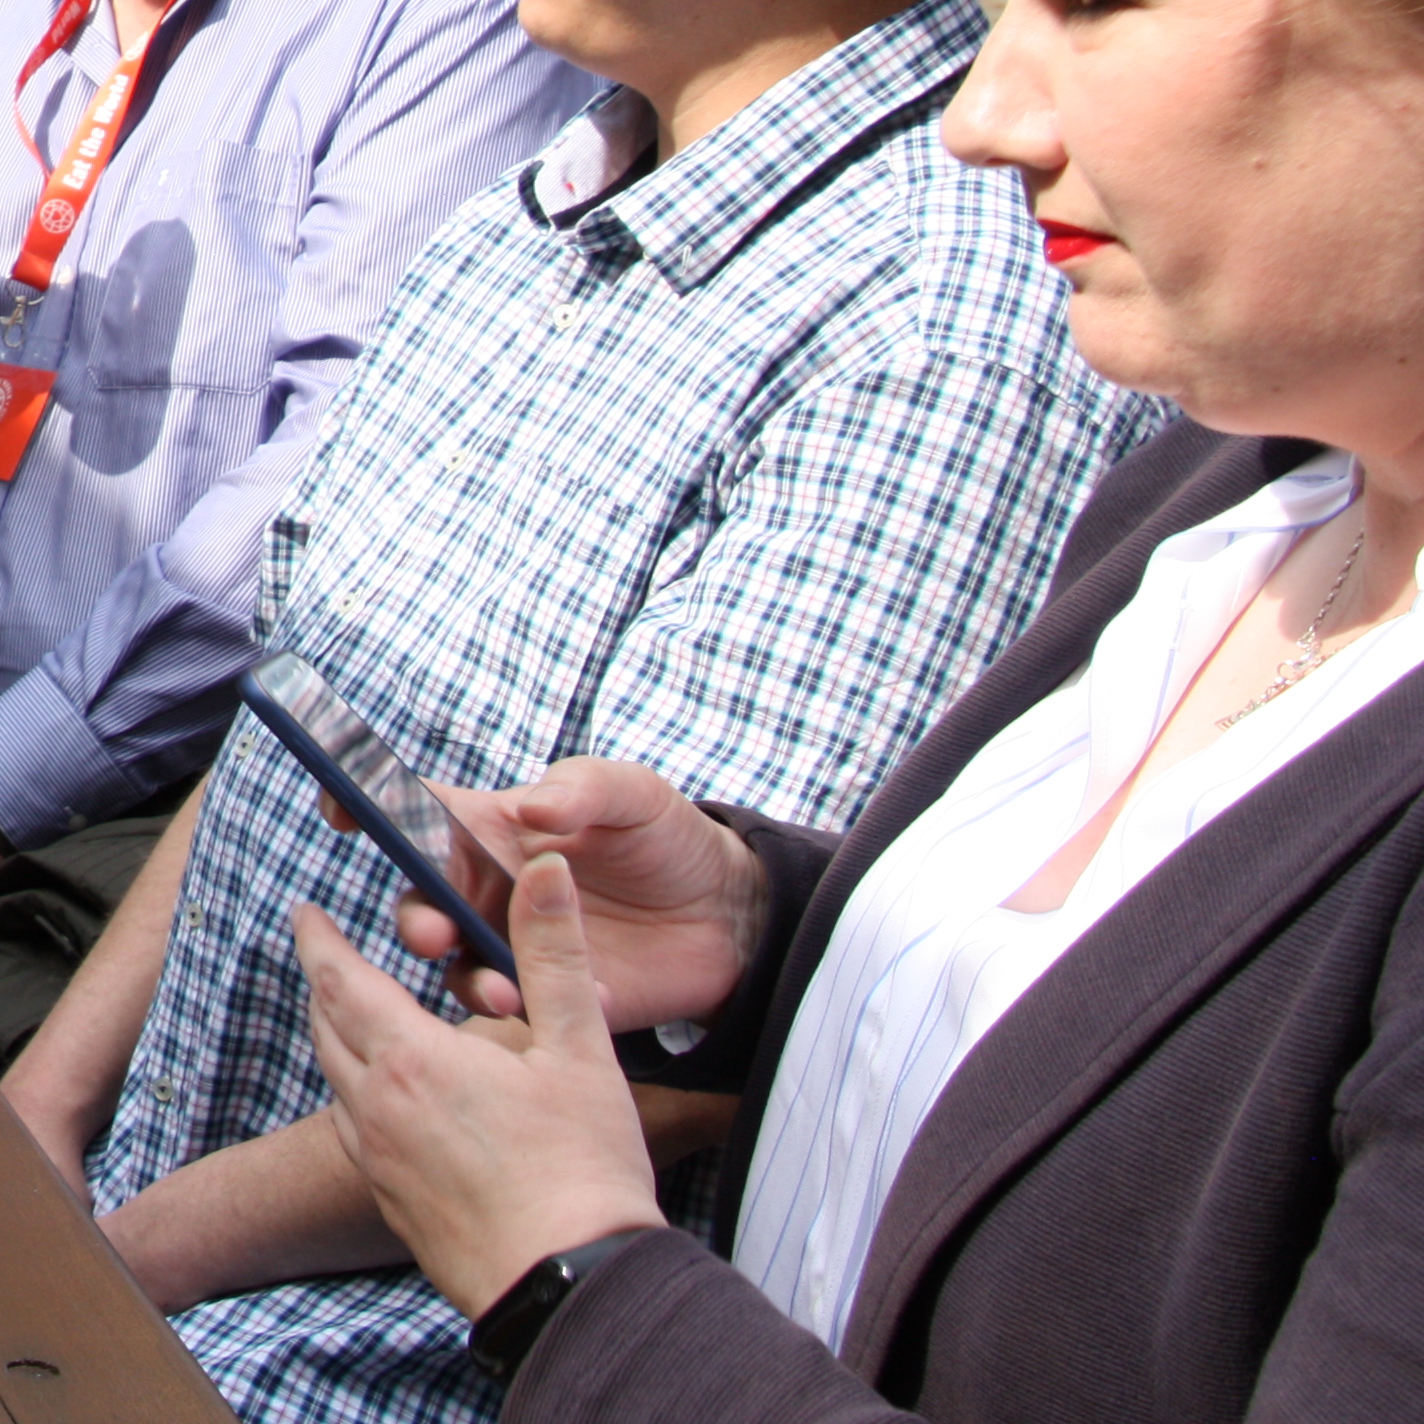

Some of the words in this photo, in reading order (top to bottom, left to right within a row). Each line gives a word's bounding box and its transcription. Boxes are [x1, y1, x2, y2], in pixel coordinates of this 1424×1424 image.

[92, 73, 130, 124] World
[77, 126, 107, 158] the
[62, 159, 93, 191] Eat
